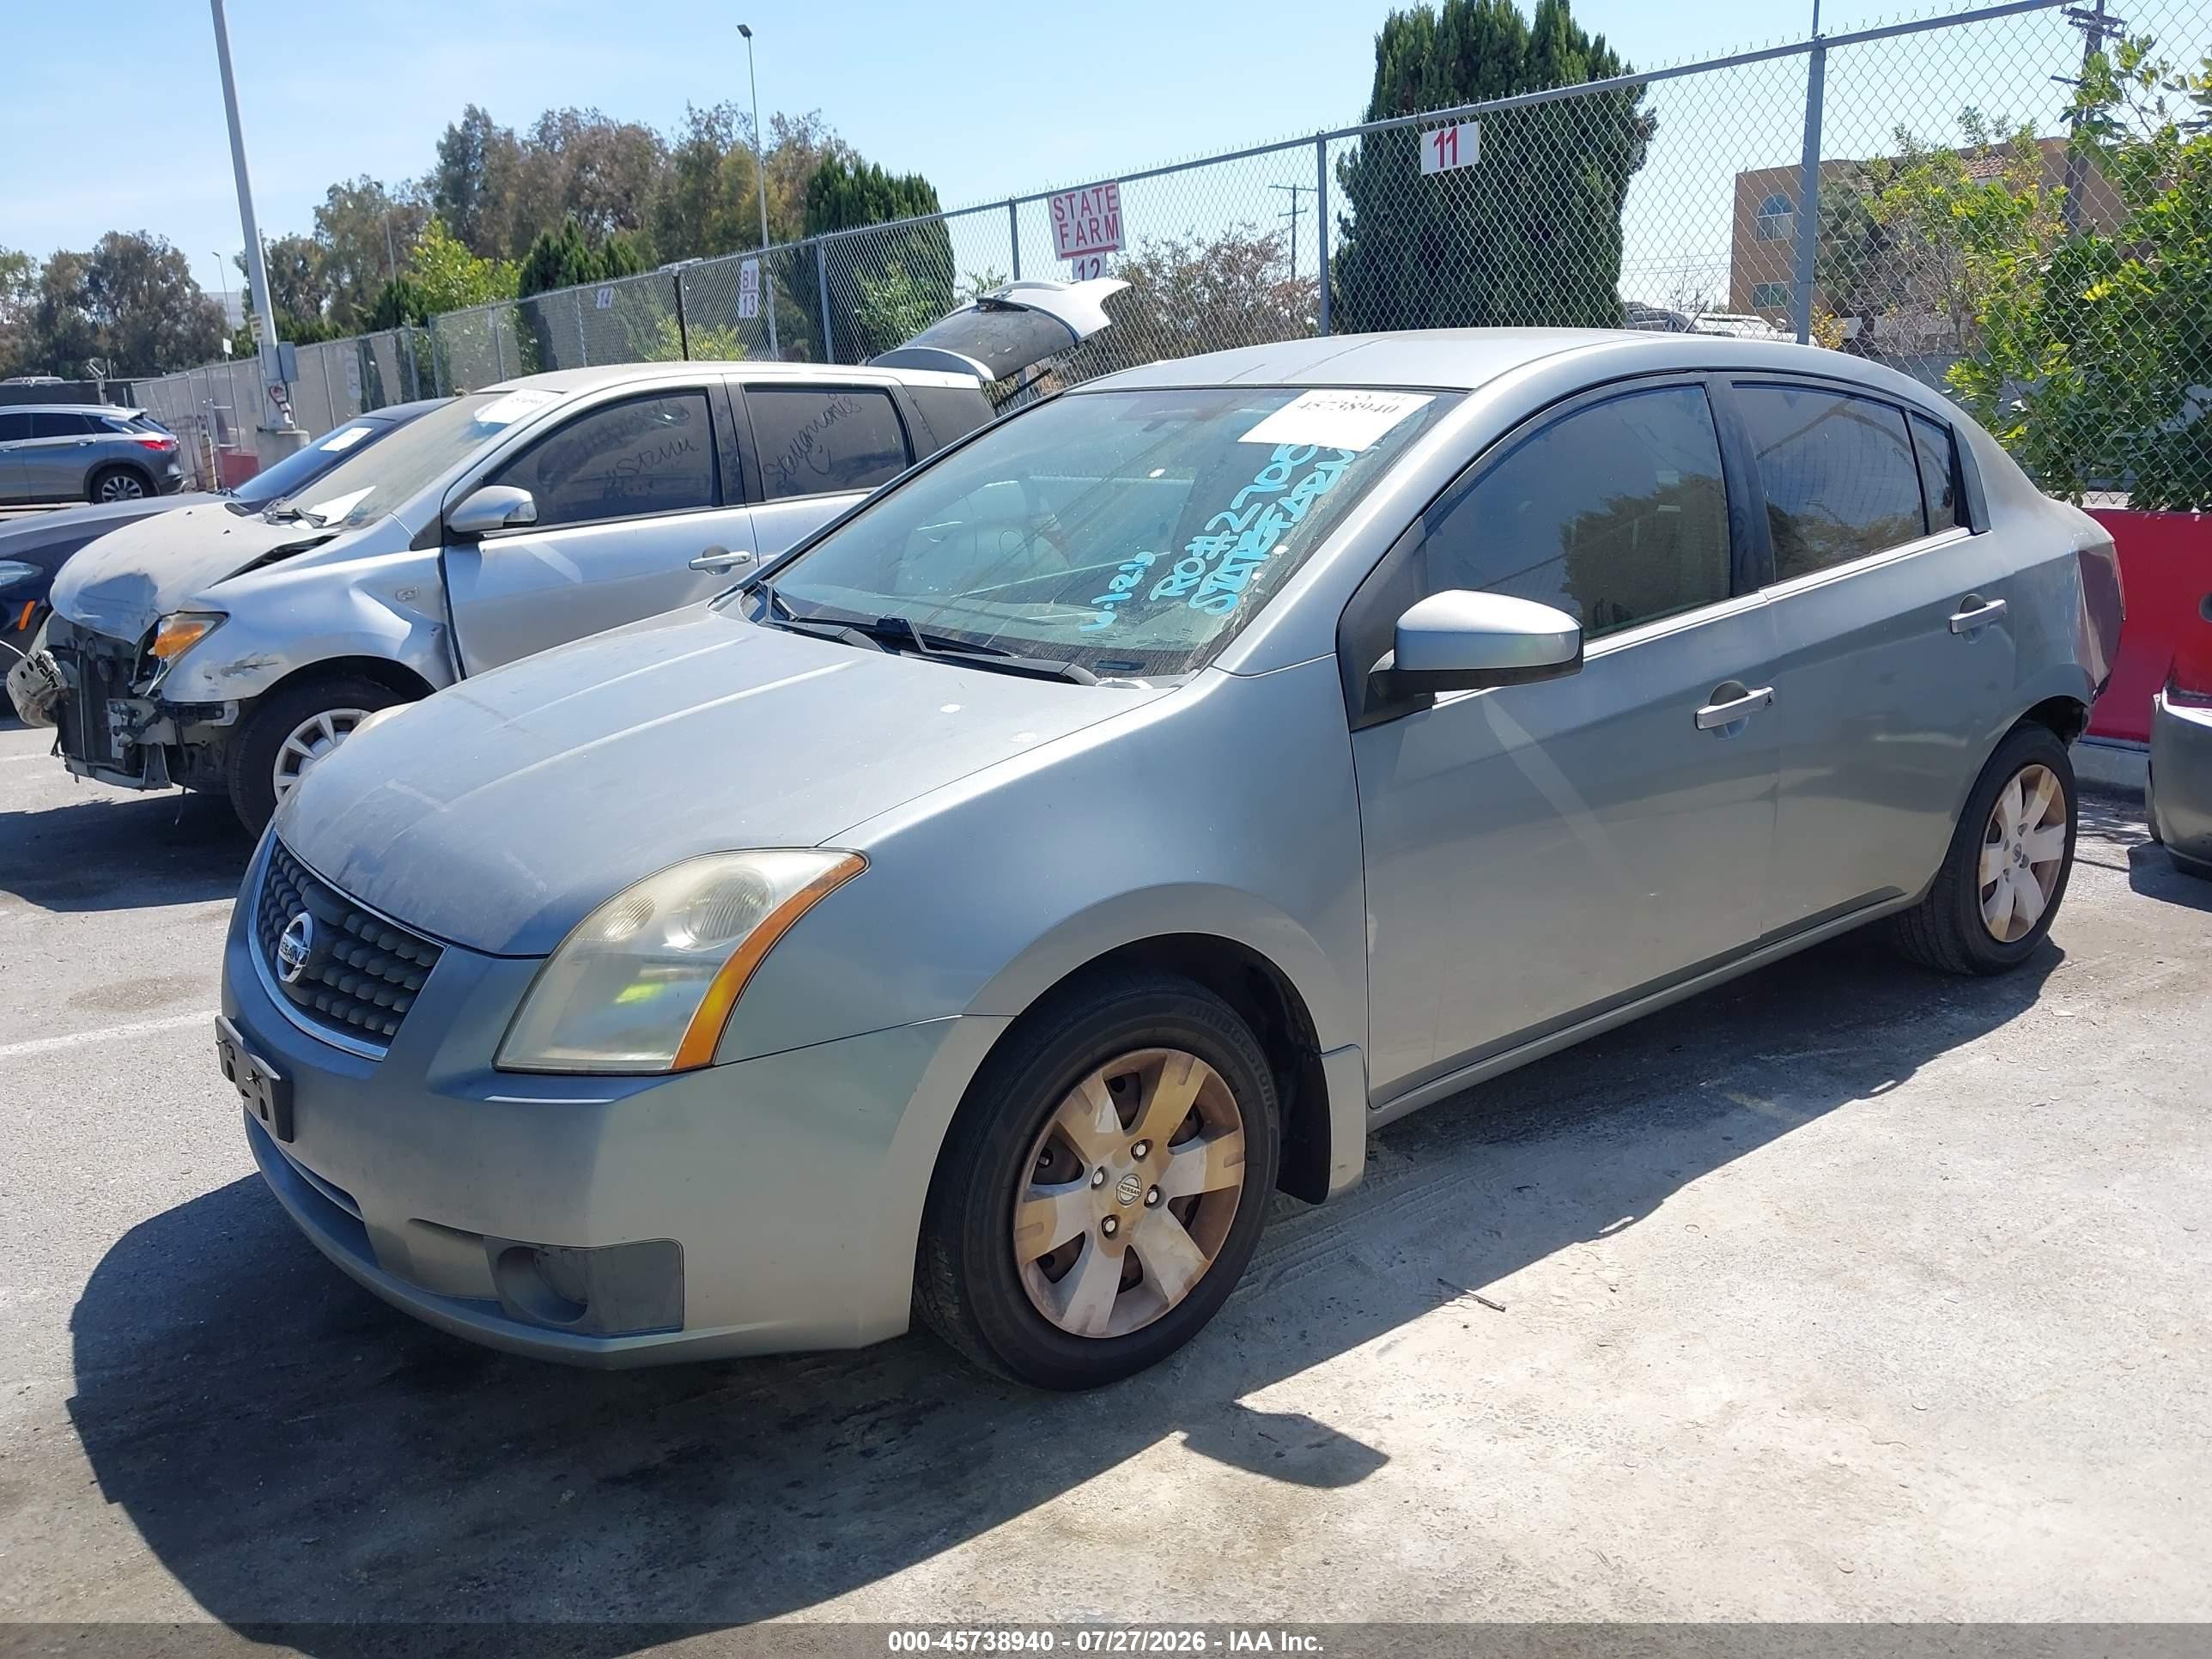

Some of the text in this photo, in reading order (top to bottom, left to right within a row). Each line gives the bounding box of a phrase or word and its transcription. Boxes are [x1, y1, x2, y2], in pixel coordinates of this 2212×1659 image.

[1433, 127, 1457, 168] 11
[1053, 184, 1119, 222] STATE
[1059, 213, 1120, 249] FARM
[1078, 258, 1100, 281] 12
[744, 295, 756, 316] 13
